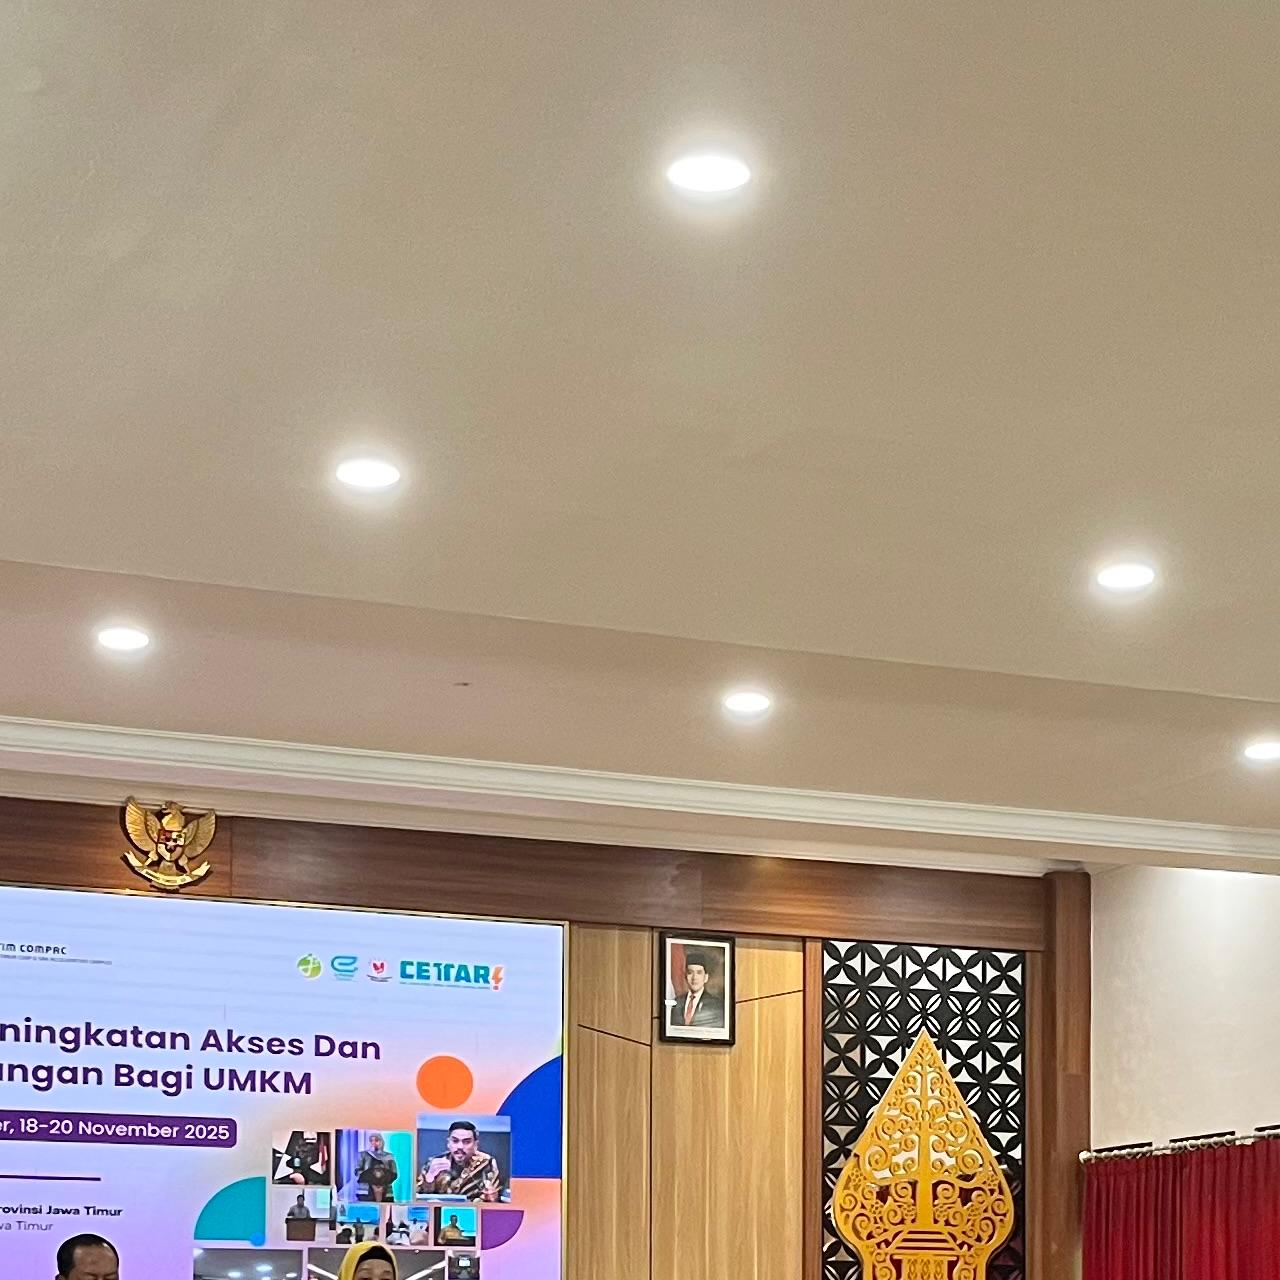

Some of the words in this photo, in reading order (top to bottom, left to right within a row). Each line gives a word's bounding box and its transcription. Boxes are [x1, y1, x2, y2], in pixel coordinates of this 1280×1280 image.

[20, 944, 67, 955] COMPAC
[200, 1029, 304, 1056] Akses
[314, 1034, 381, 1060] Dan
[114, 1063, 193, 1097] Bagi
[203, 1067, 312, 1095] UMKM
[19, 1118, 73, 1135] 18-20
[78, 1121, 180, 1138] November
[184, 1125, 230, 1140] 2025
[46, 1205, 80, 1216] Jawa
[83, 1206, 123, 1217] Timur
[15, 1220, 54, 1231] Timur
